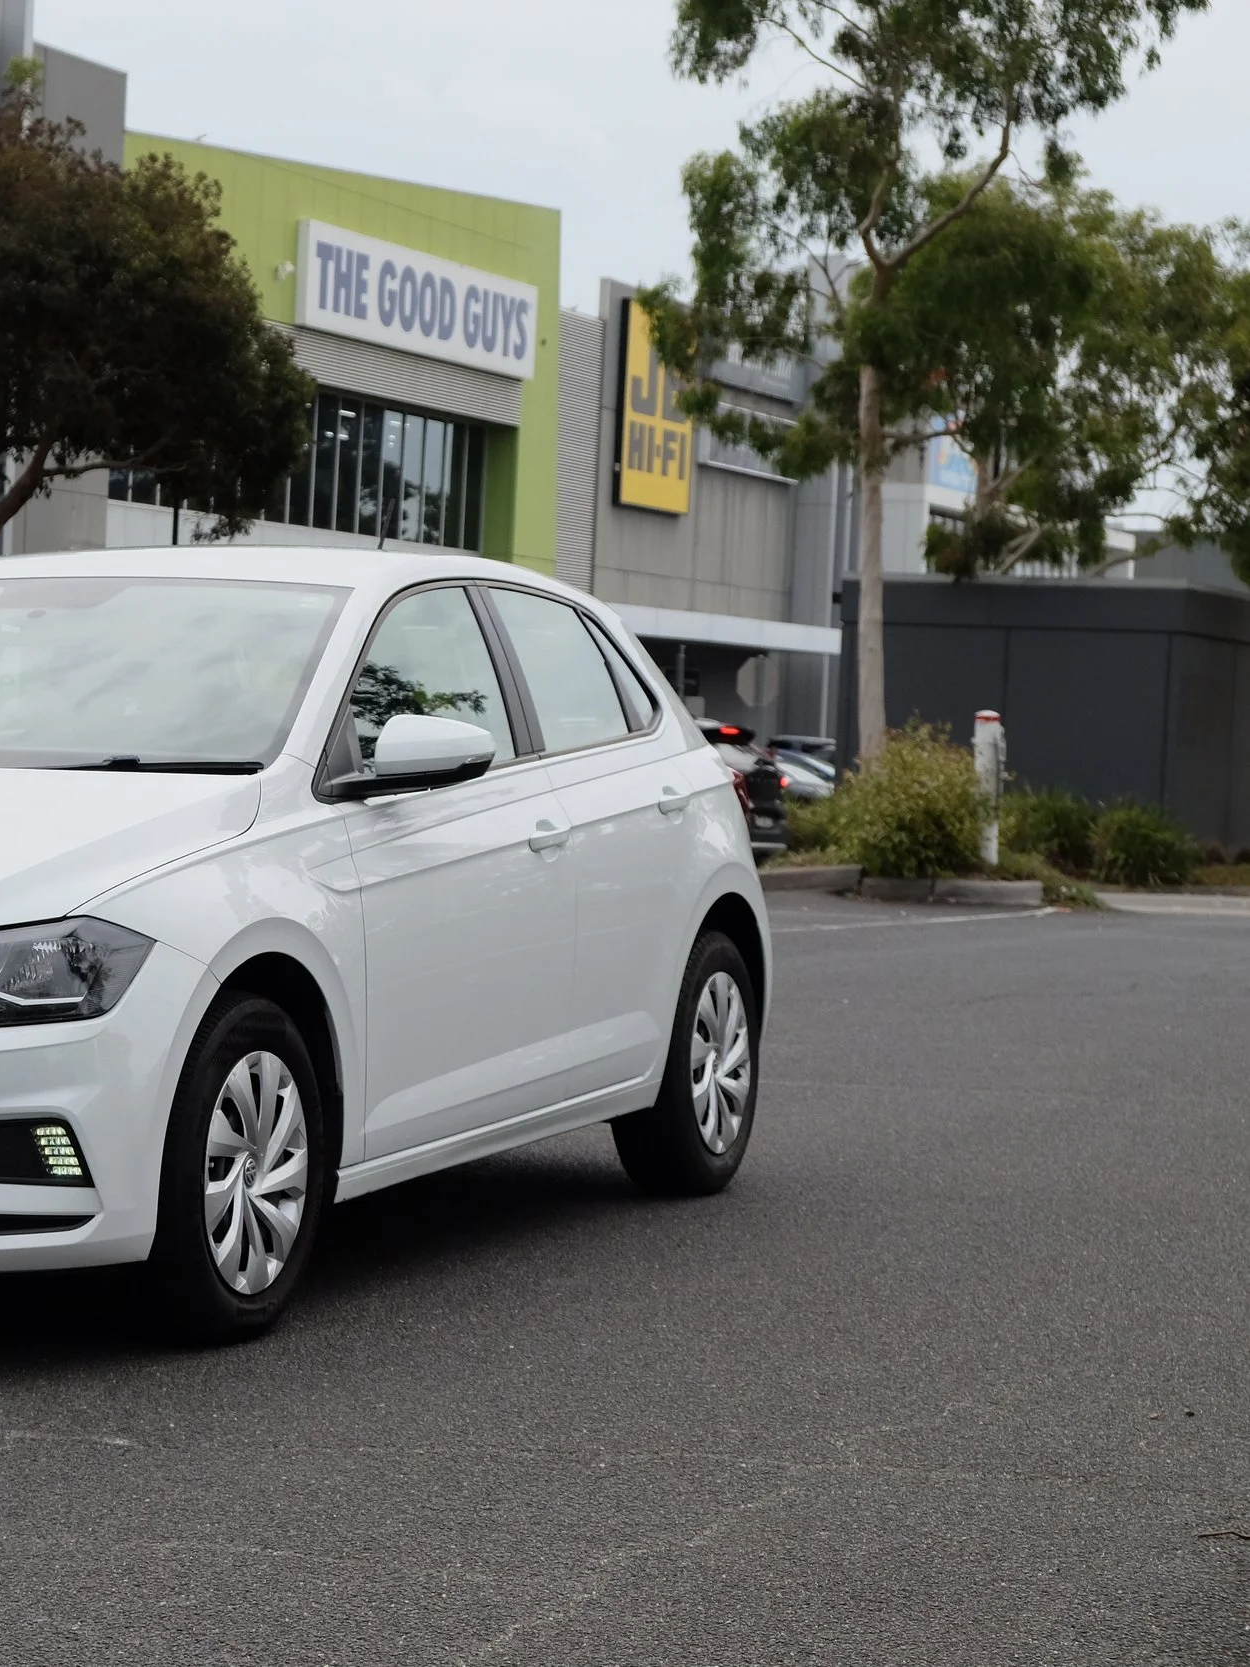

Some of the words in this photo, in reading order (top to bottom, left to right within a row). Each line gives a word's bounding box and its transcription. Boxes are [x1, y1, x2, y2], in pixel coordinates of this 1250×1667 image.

[317, 240, 370, 320] THE
[378, 259, 457, 341] GOOD
[463, 284, 529, 361] GUYS
